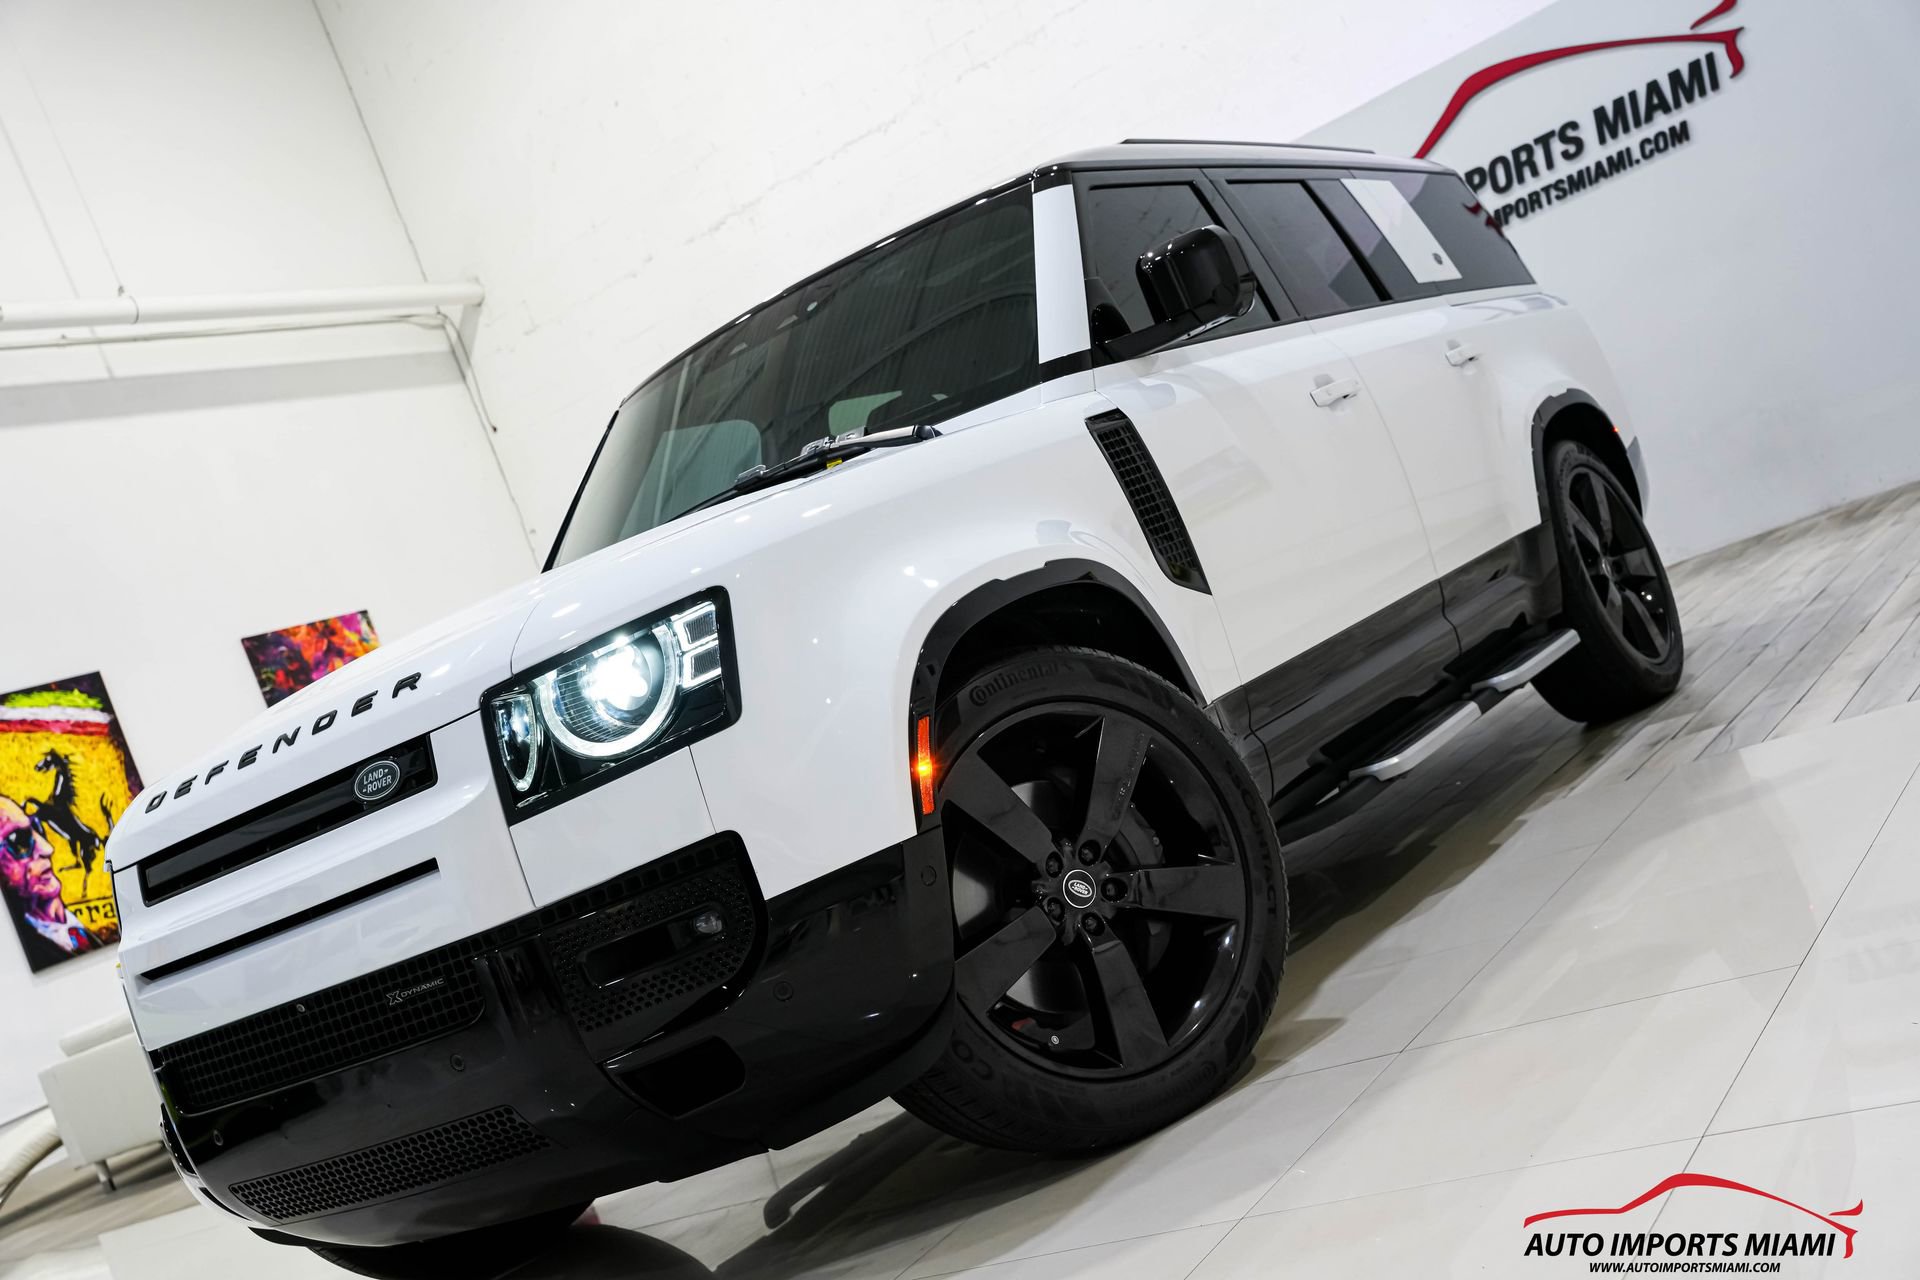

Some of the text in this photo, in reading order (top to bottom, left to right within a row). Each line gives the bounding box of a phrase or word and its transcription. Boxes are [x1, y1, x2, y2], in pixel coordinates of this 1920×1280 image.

[1593, 52, 1720, 146] MIAMI
[145, 671, 422, 814] DEFENDER
[400, 978, 445, 998] DYNAMIC
